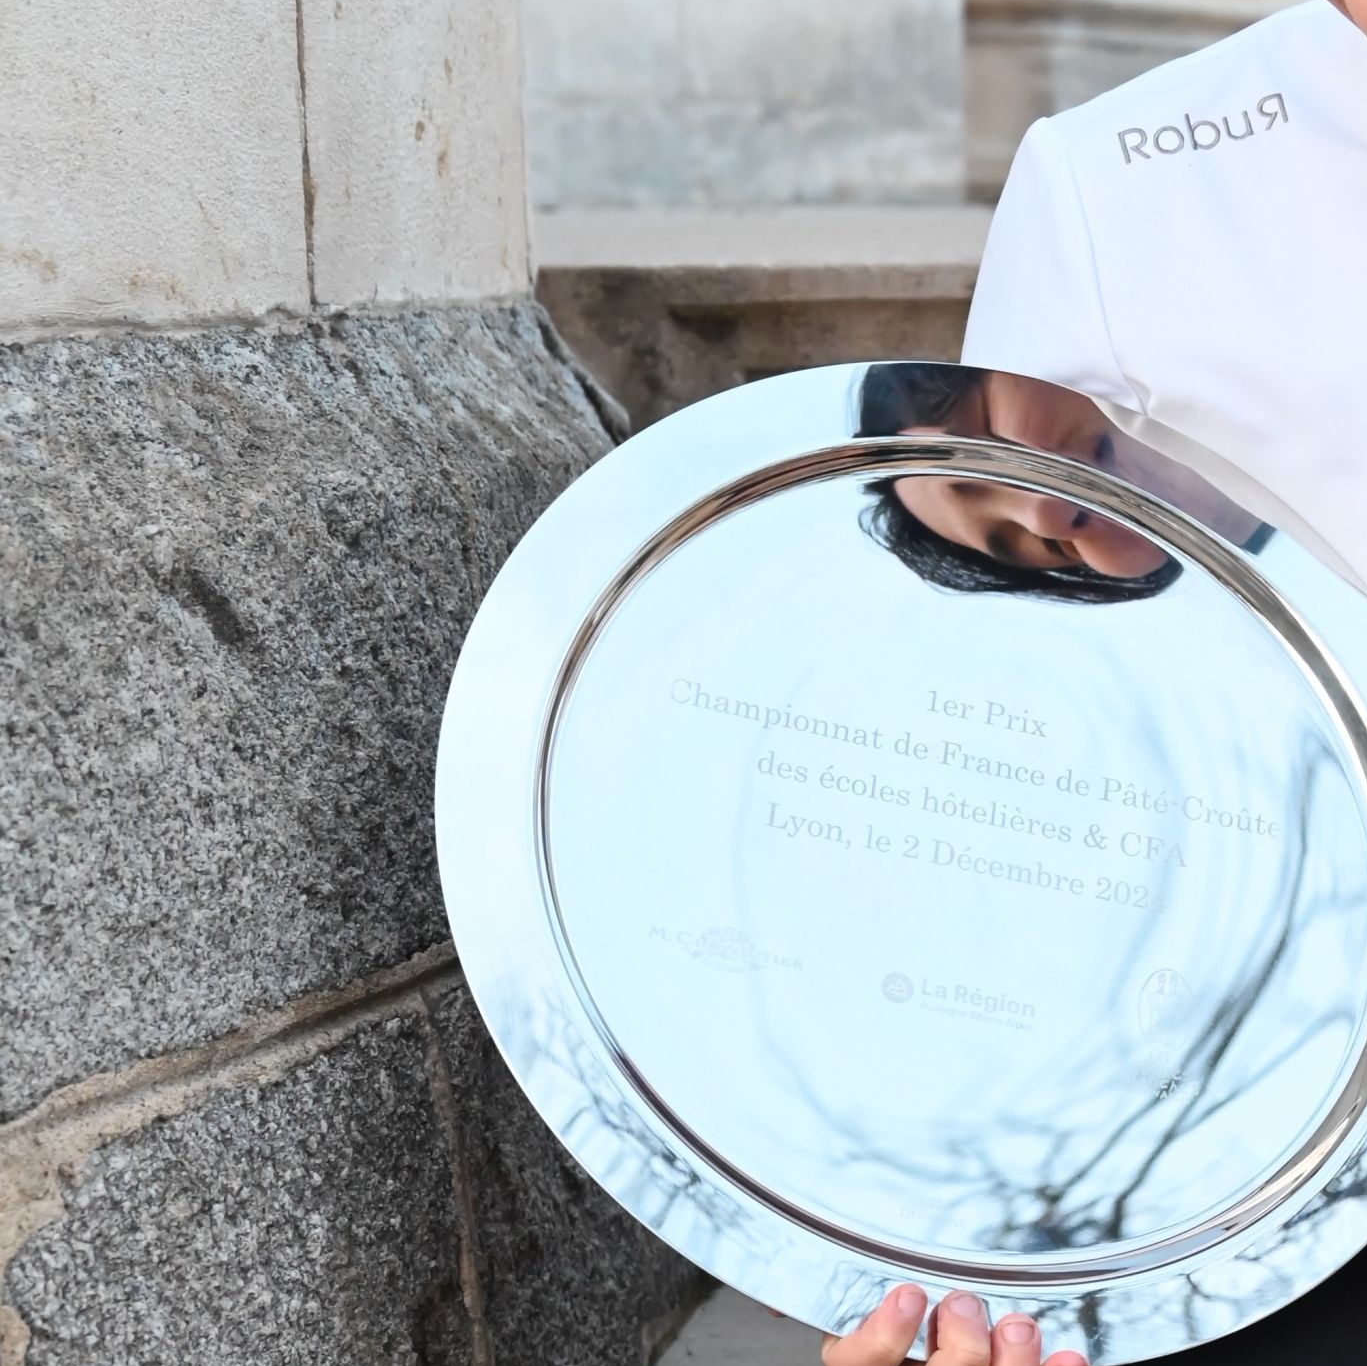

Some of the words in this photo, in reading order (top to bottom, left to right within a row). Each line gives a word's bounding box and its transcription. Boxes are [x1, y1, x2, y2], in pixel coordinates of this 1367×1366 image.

[927, 690, 974, 720] 1er
[983, 700, 1048, 738] Prix
[670, 678, 884, 750] Championnat
[894, 732, 929, 760] de
[939, 740, 1046, 786] France
[1056, 768, 1090, 796] de
[1100, 776, 1280, 838] Pâté-Croûte
[757, 750, 808, 783] des
[819, 764, 910, 806] écoles
[920, 787, 1072, 842] hôtelières
[1083, 823, 1108, 850] &
[1120, 832, 1188, 868] CFA
[765, 801, 852, 849] Lyon,
[864, 824, 891, 852] le
[902, 835, 920, 859] 2
[929, 839, 1085, 895] Décembre
[648, 924, 672, 942] M.
[920, 977, 947, 999] La
[953, 984, 1036, 1018] Région
